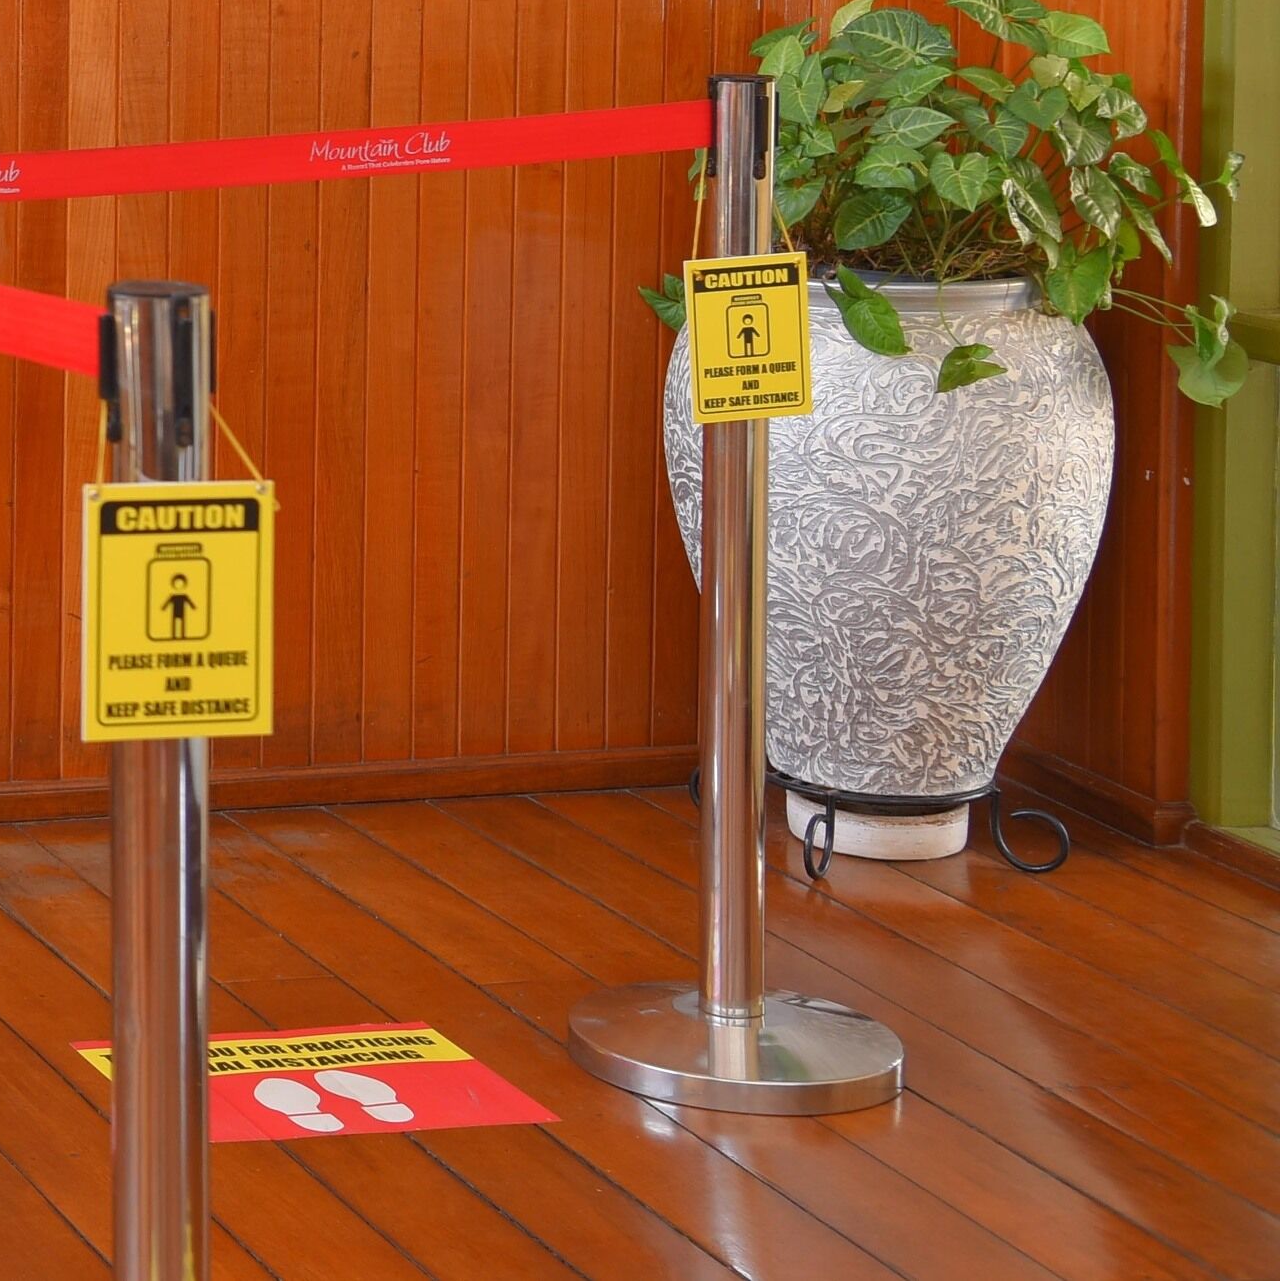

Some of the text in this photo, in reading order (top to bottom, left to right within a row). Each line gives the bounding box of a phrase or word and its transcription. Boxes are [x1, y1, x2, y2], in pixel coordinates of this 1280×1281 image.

[309, 131, 451, 162] Mountain Club
[705, 268, 789, 289] CAUTION
[704, 361, 797, 378] PLEASE FORM A QUEUE
[742, 379, 759, 390] AND
[704, 391, 800, 409] KEEP SAFE DISTANCE
[115, 504, 245, 532] CAUTION
[108, 650, 248, 670] PLEASE FORM A QUEUE
[165, 676, 192, 692] AND
[106, 698, 250, 718] KEEP SAFE DISTANCE
[208, 1035, 437, 1058] OU FOR PRACTICING
[254, 1049, 425, 1068] DISTANCING
